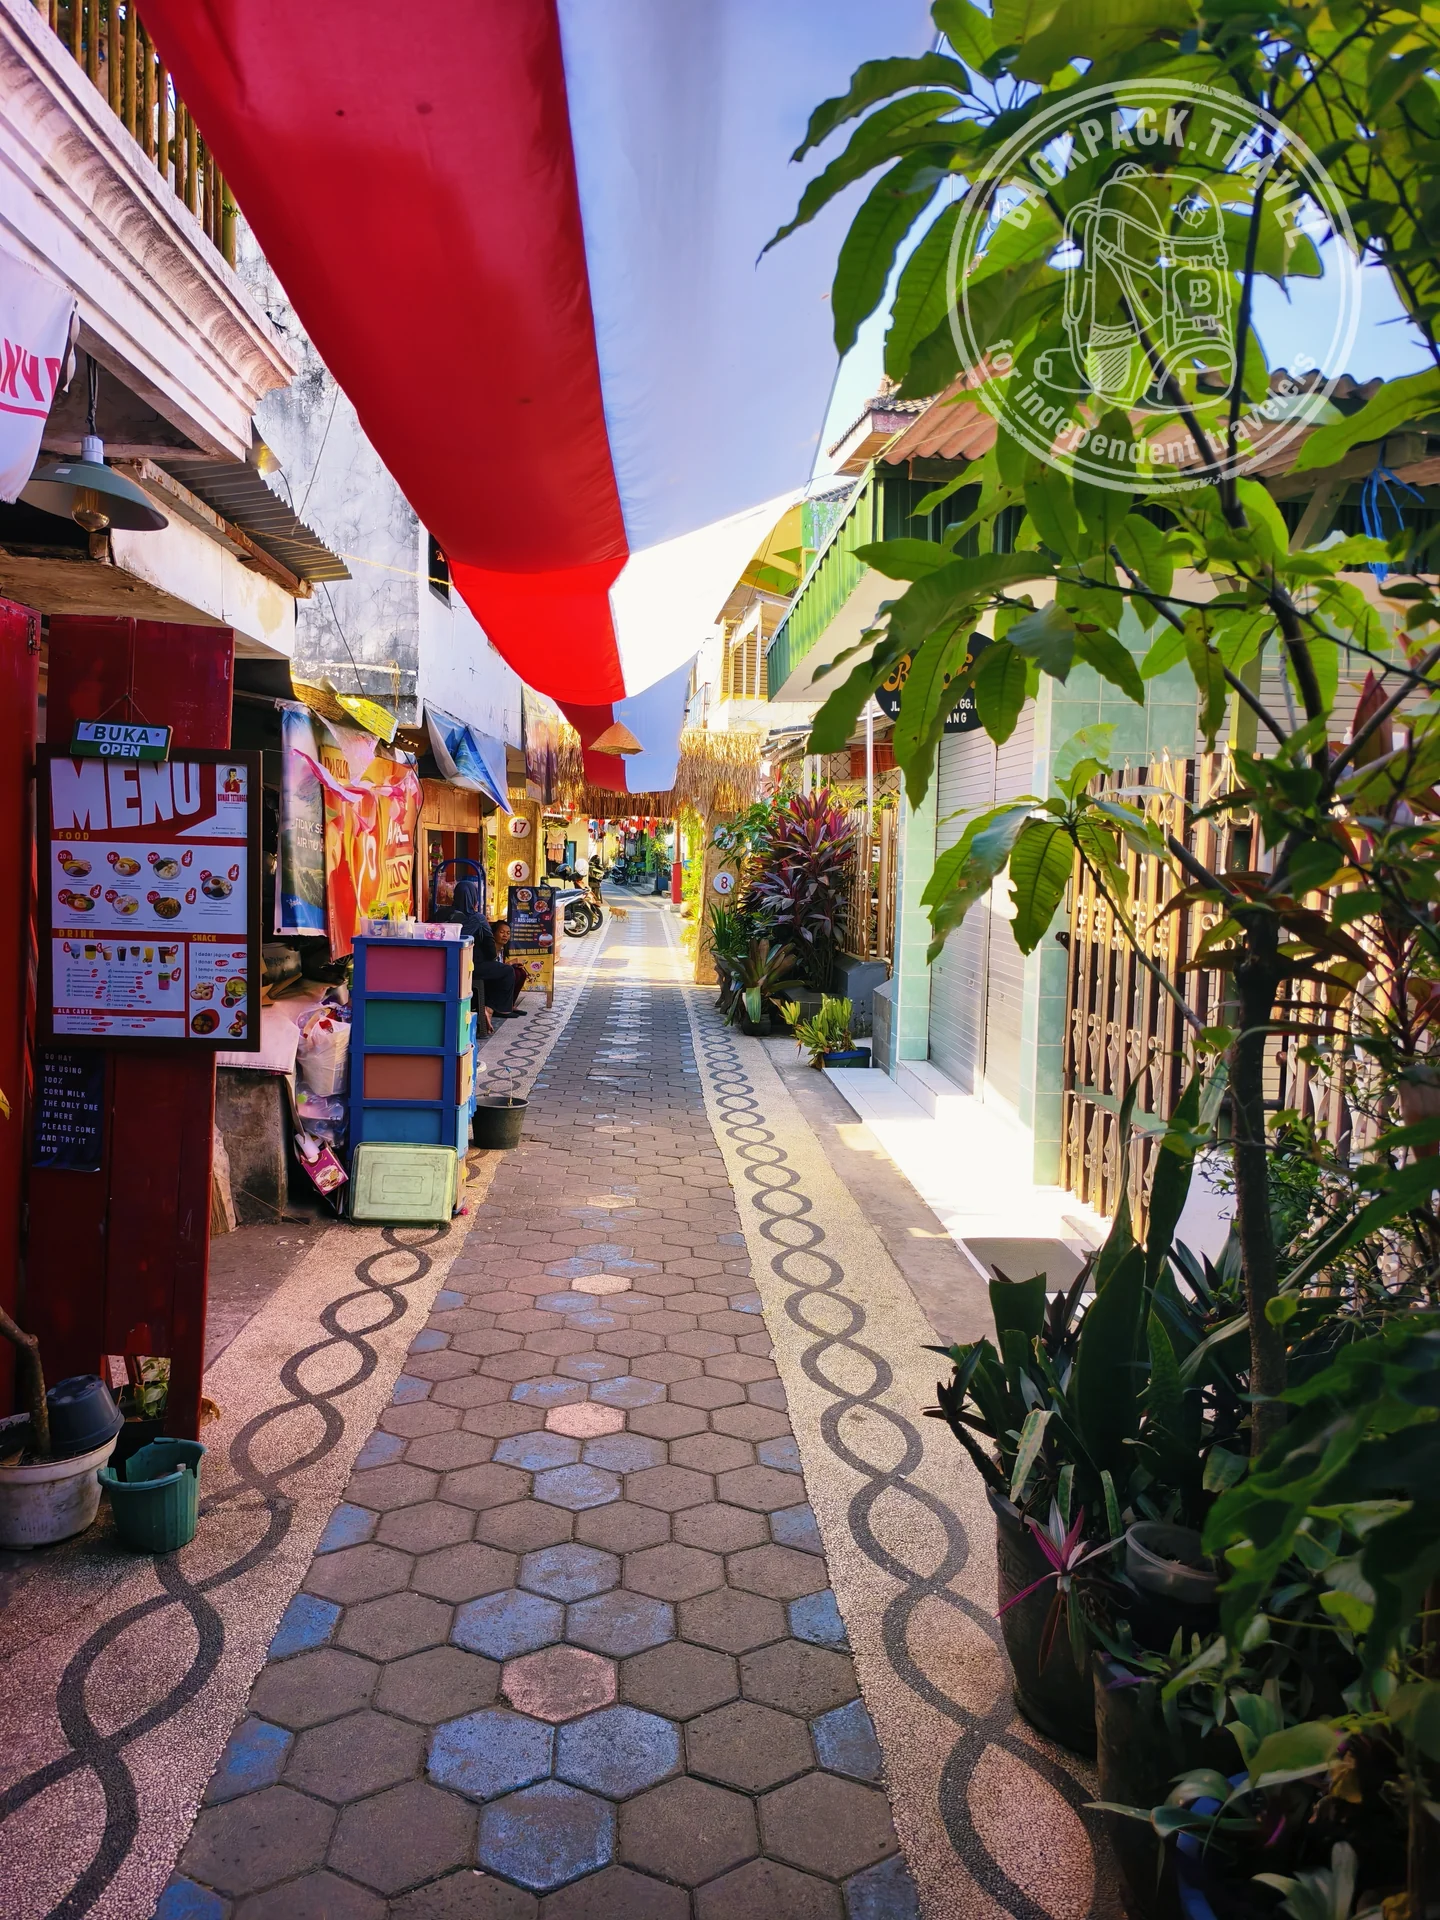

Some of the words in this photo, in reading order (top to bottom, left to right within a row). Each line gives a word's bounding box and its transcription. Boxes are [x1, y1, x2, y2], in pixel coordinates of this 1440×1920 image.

[890, 701, 900, 712] JL.
[94, 725, 149, 743] BUKA
[100, 743, 141, 757] OPEN
[51, 758, 200, 830] MENU
[512, 822, 527, 834] 17
[58, 831, 90, 841] FOOD
[514, 864, 523, 878] 8
[721, 876, 728, 889] 8
[58, 929, 95, 938] DRINK
[192, 934, 217, 942] SNACK
[44, 1076, 63, 1084] 100%
[44, 1088, 64, 1096] CORN
[67, 1090, 86, 1098] MILK
[61, 1101, 80, 1109] ONLY
[83, 1103, 98, 1111] ONE
[54, 1112, 73, 1120] HERE
[42, 1122, 72, 1132] PLEASE
[75, 1125, 96, 1134] COME
[40, 1146, 58, 1154] NOW
